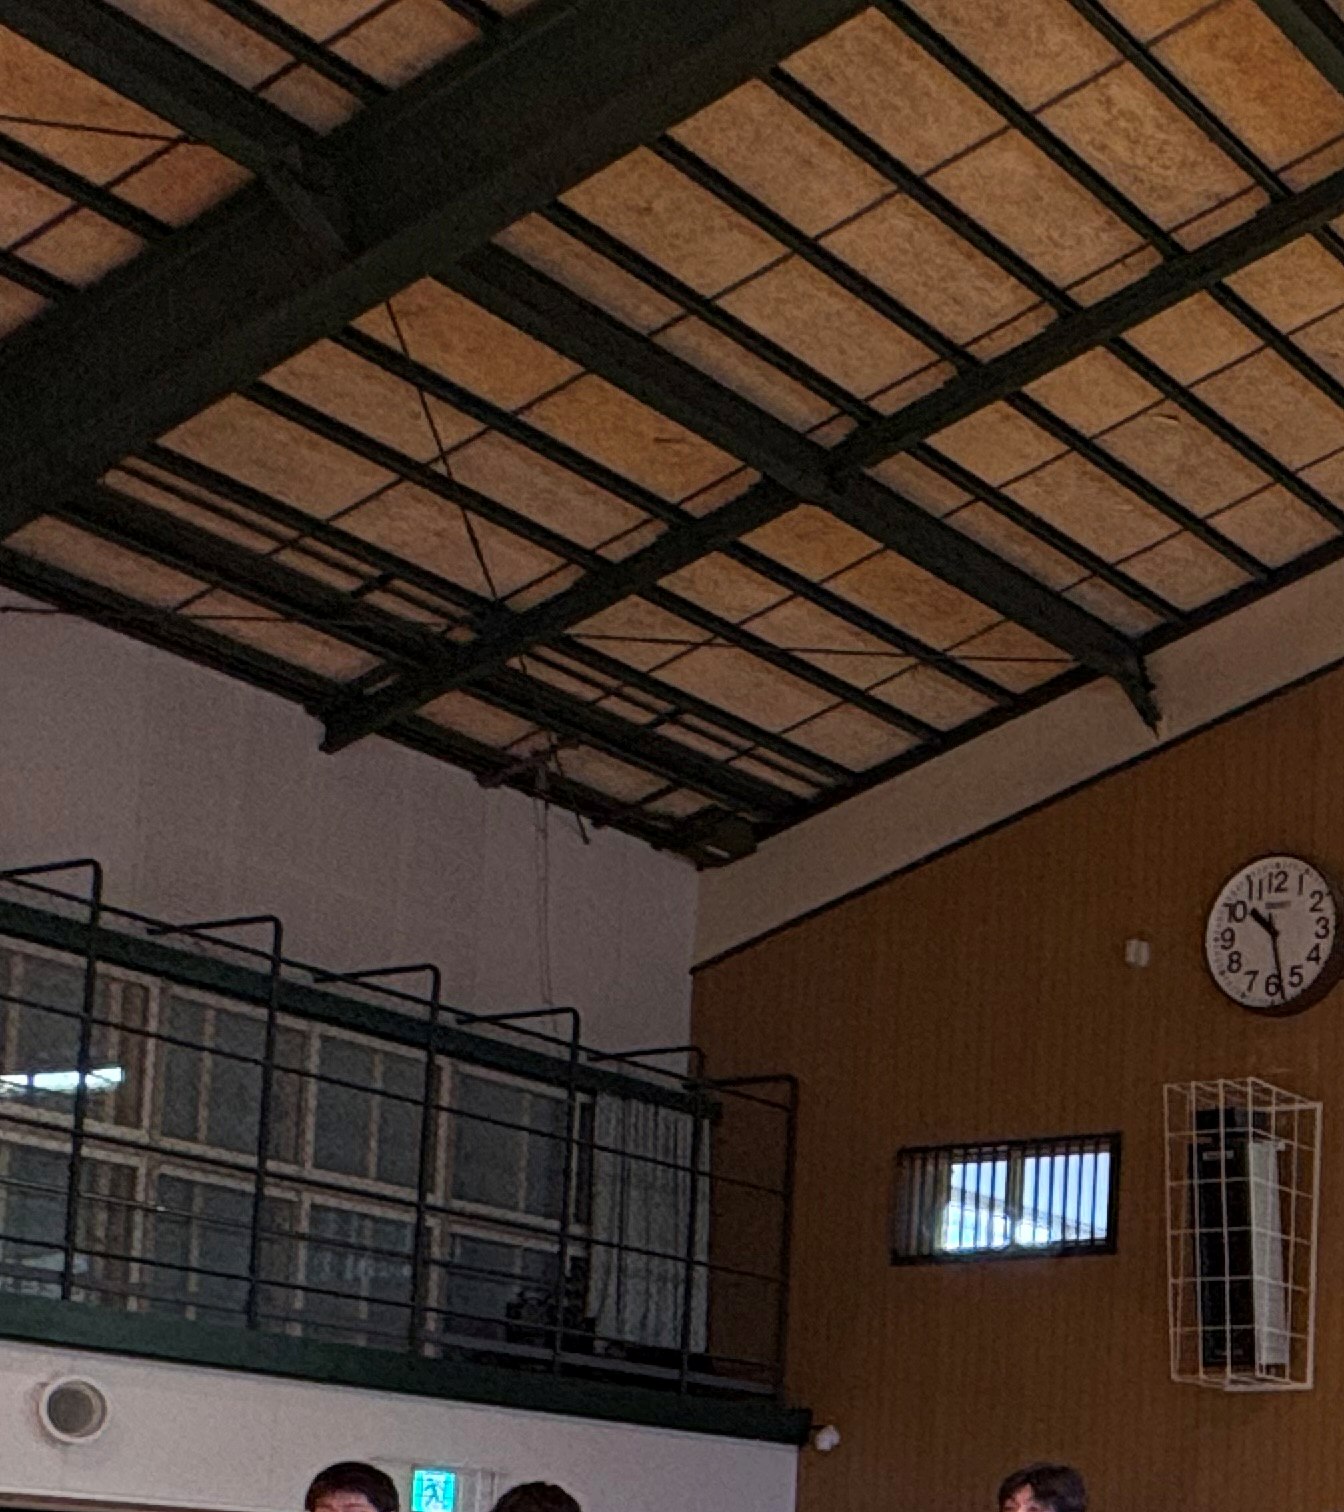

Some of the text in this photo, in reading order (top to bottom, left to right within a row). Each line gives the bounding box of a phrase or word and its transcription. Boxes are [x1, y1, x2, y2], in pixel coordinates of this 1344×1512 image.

[1246, 874, 1263, 901] 11
[1268, 870, 1288, 894] 12
[1223, 900, 1248, 924] 10
[1309, 890, 1324, 913] 2
[1220, 926, 1236, 950] 9
[1314, 916, 1330, 940] 3
[1227, 950, 1242, 974] 8
[1306, 943, 1321, 965] 4
[1244, 970, 1259, 993] 7
[1264, 974, 1282, 996] 6
[1289, 964, 1304, 988] 5
